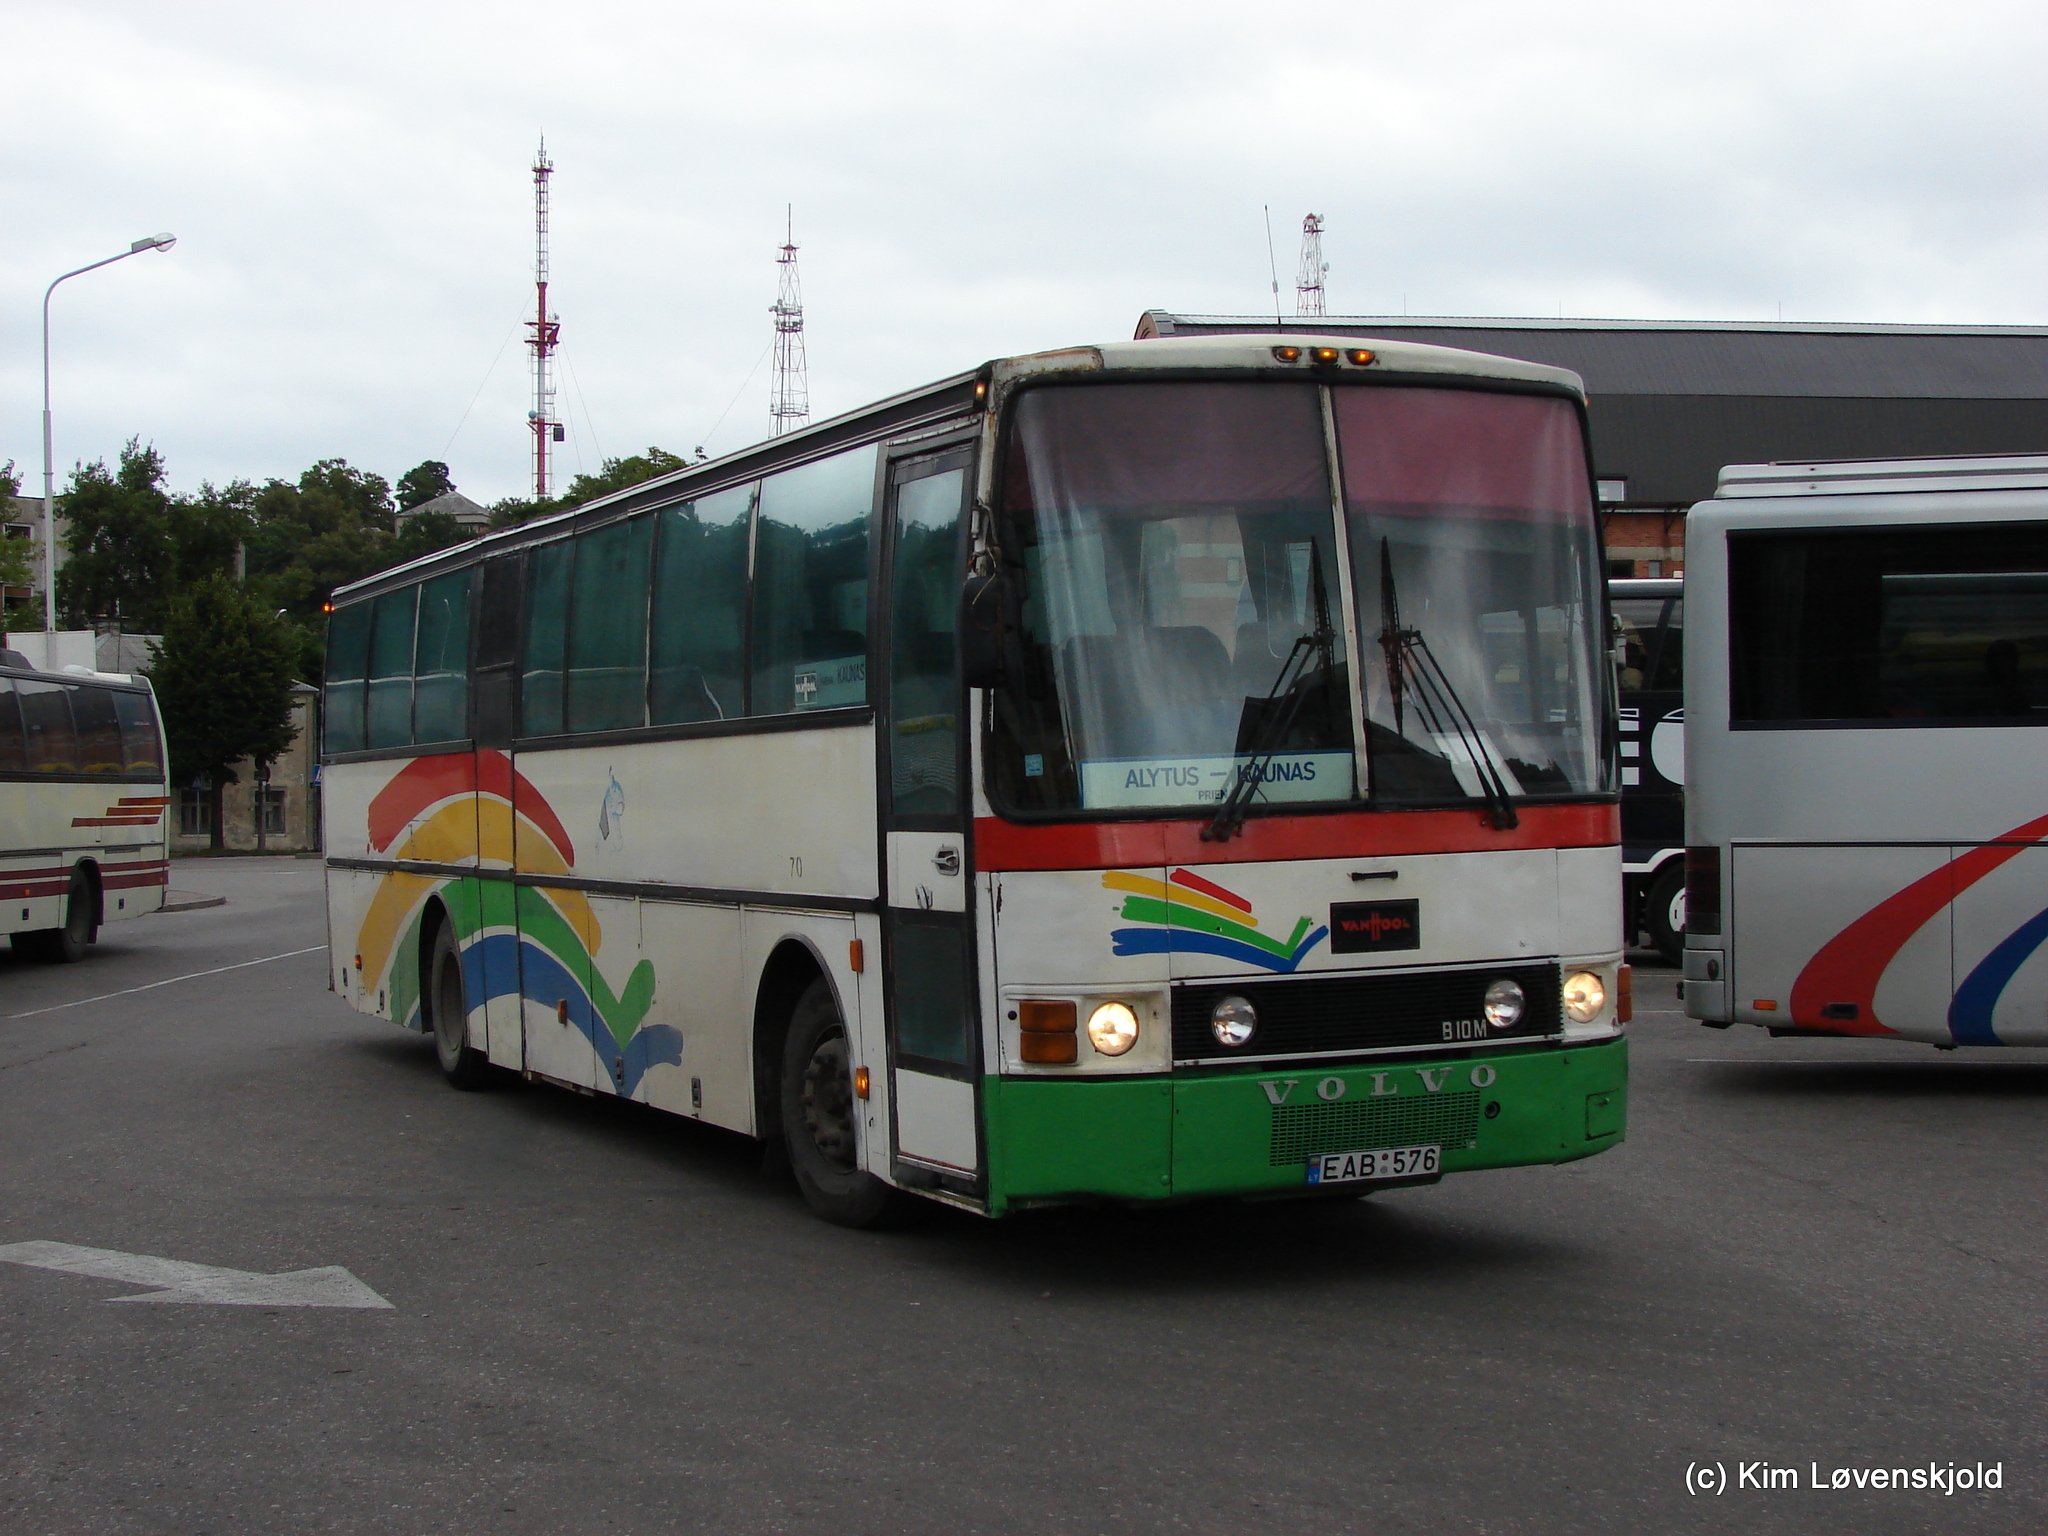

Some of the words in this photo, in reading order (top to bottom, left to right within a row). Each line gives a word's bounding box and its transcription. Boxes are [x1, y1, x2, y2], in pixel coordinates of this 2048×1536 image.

[1124, 766, 1199, 788] ALYTUS
[1236, 761, 1316, 783] KAUNAS
[1198, 789, 1228, 800] PRIEN
[789, 856, 803, 878] 70
[1441, 1018, 1487, 1041] B10M
[1257, 1064, 1497, 1105] VOLVO
[1322, 1153, 1375, 1180] EAB
[1392, 1148, 1436, 1174] 576
